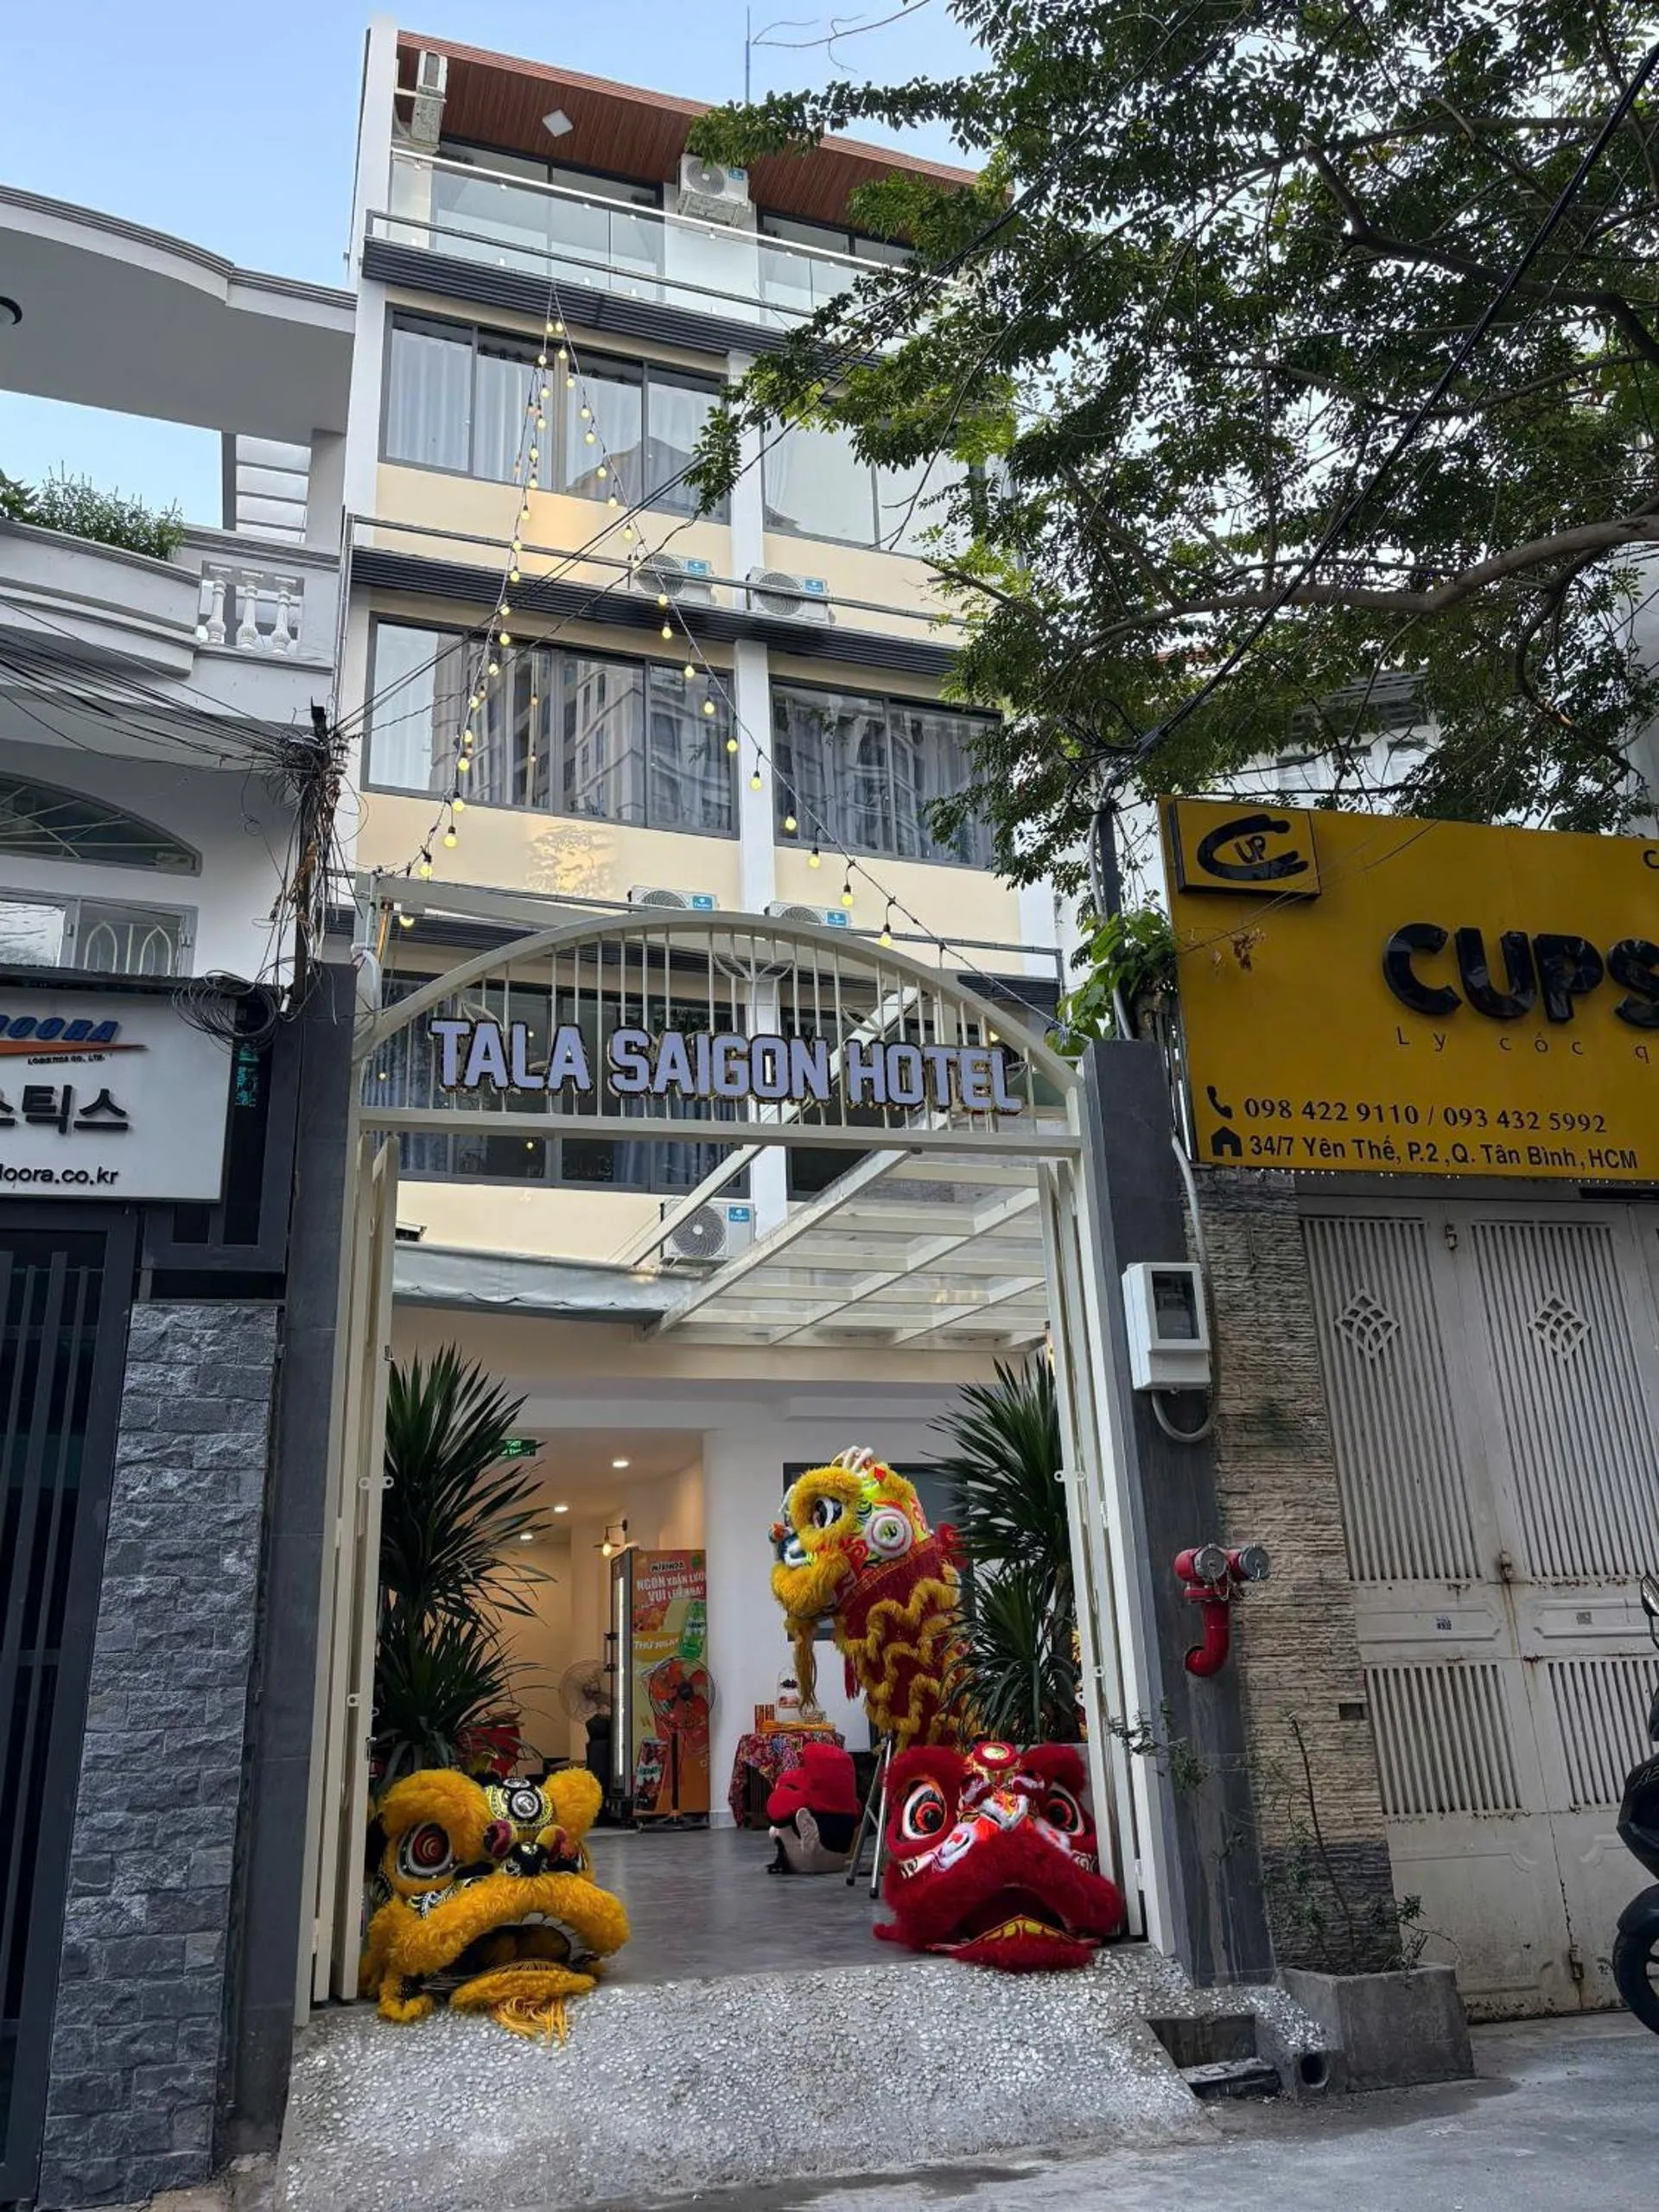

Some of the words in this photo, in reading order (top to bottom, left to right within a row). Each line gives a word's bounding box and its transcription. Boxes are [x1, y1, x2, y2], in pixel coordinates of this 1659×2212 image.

[1397, 1026, 1446, 1052] Ly
[429, 1018, 593, 1094] TALA
[607, 1025, 832, 1103] SAIGON
[843, 1039, 1023, 1116] HOTEL
[1244, 1098, 1292, 1118] 098
[1302, 1101, 1348, 1121] 422
[1357, 1102, 1418, 1124] 9110
[1444, 1106, 1488, 1127] 093
[1497, 1109, 1540, 1130] 432
[1549, 1112, 1606, 1133] 5992
[1249, 1135, 1294, 1156] 34/7
[1302, 1136, 1345, 1159] Yên
[1352, 1135, 1401, 1164] Thế,
[1479, 1143, 1521, 1164] Tân
[1588, 1148, 1638, 1168] HCM
